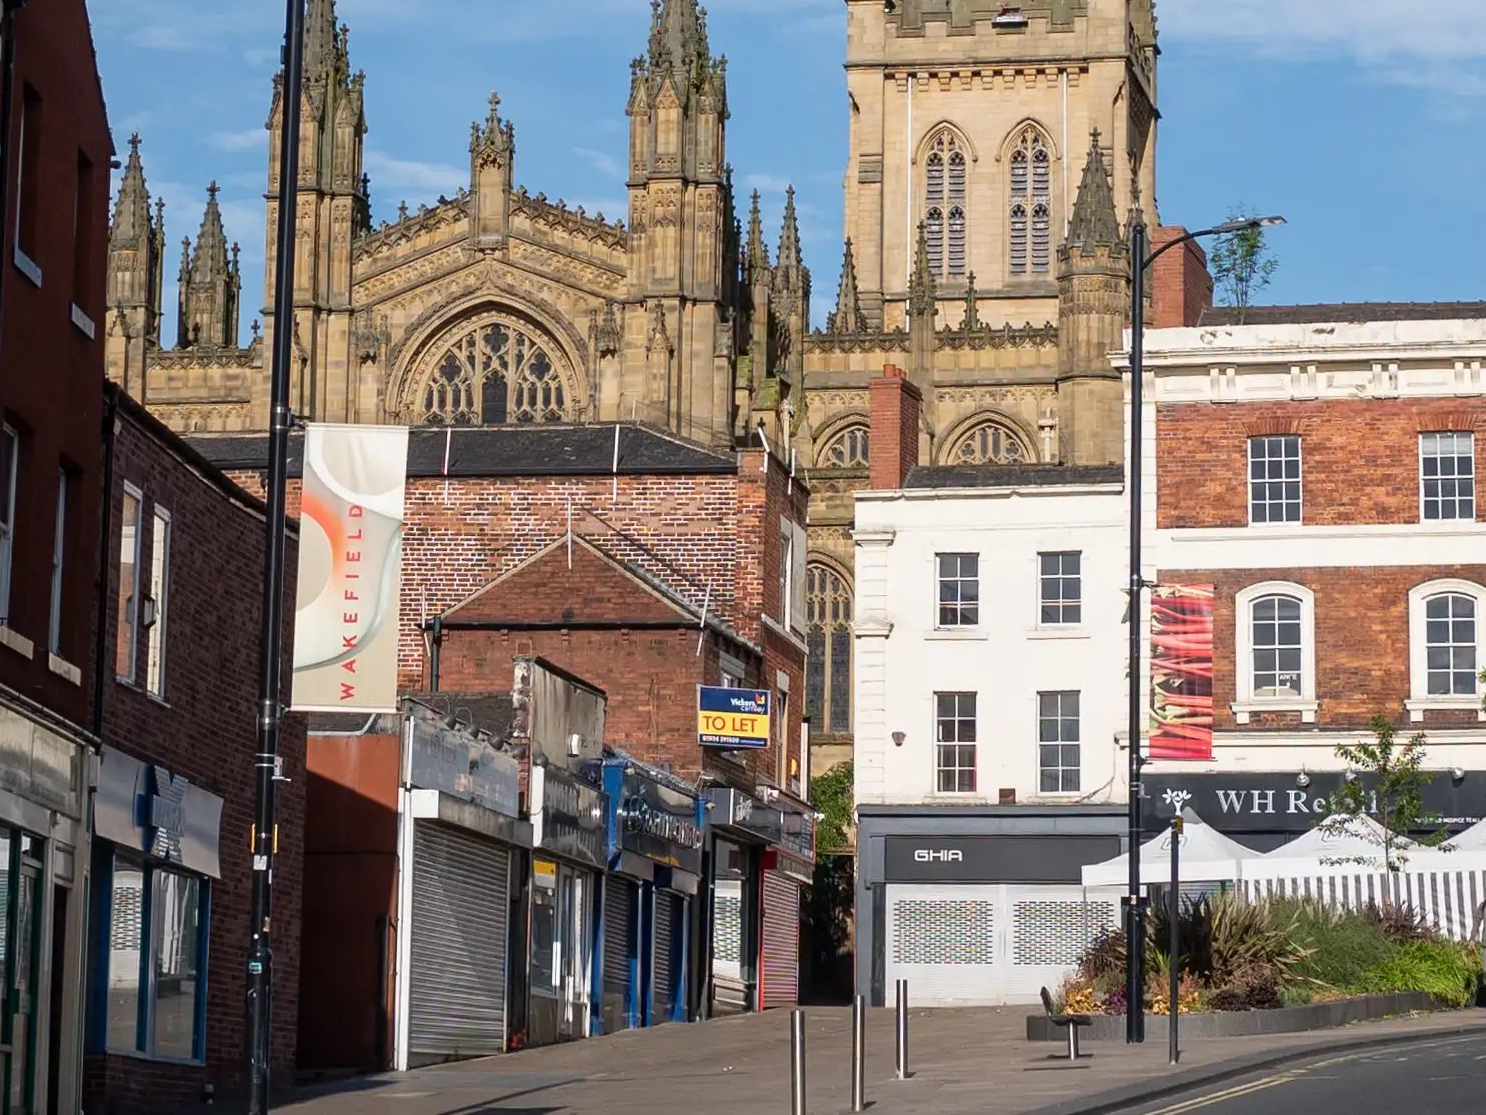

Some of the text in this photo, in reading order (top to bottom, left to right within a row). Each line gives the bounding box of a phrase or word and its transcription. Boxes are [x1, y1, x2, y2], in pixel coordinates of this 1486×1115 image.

[340, 504, 363, 701] WAKEFIELD
[703, 715, 758, 733] TO LET
[1215, 789, 1276, 814] WH
[914, 849, 963, 862] GHIA
